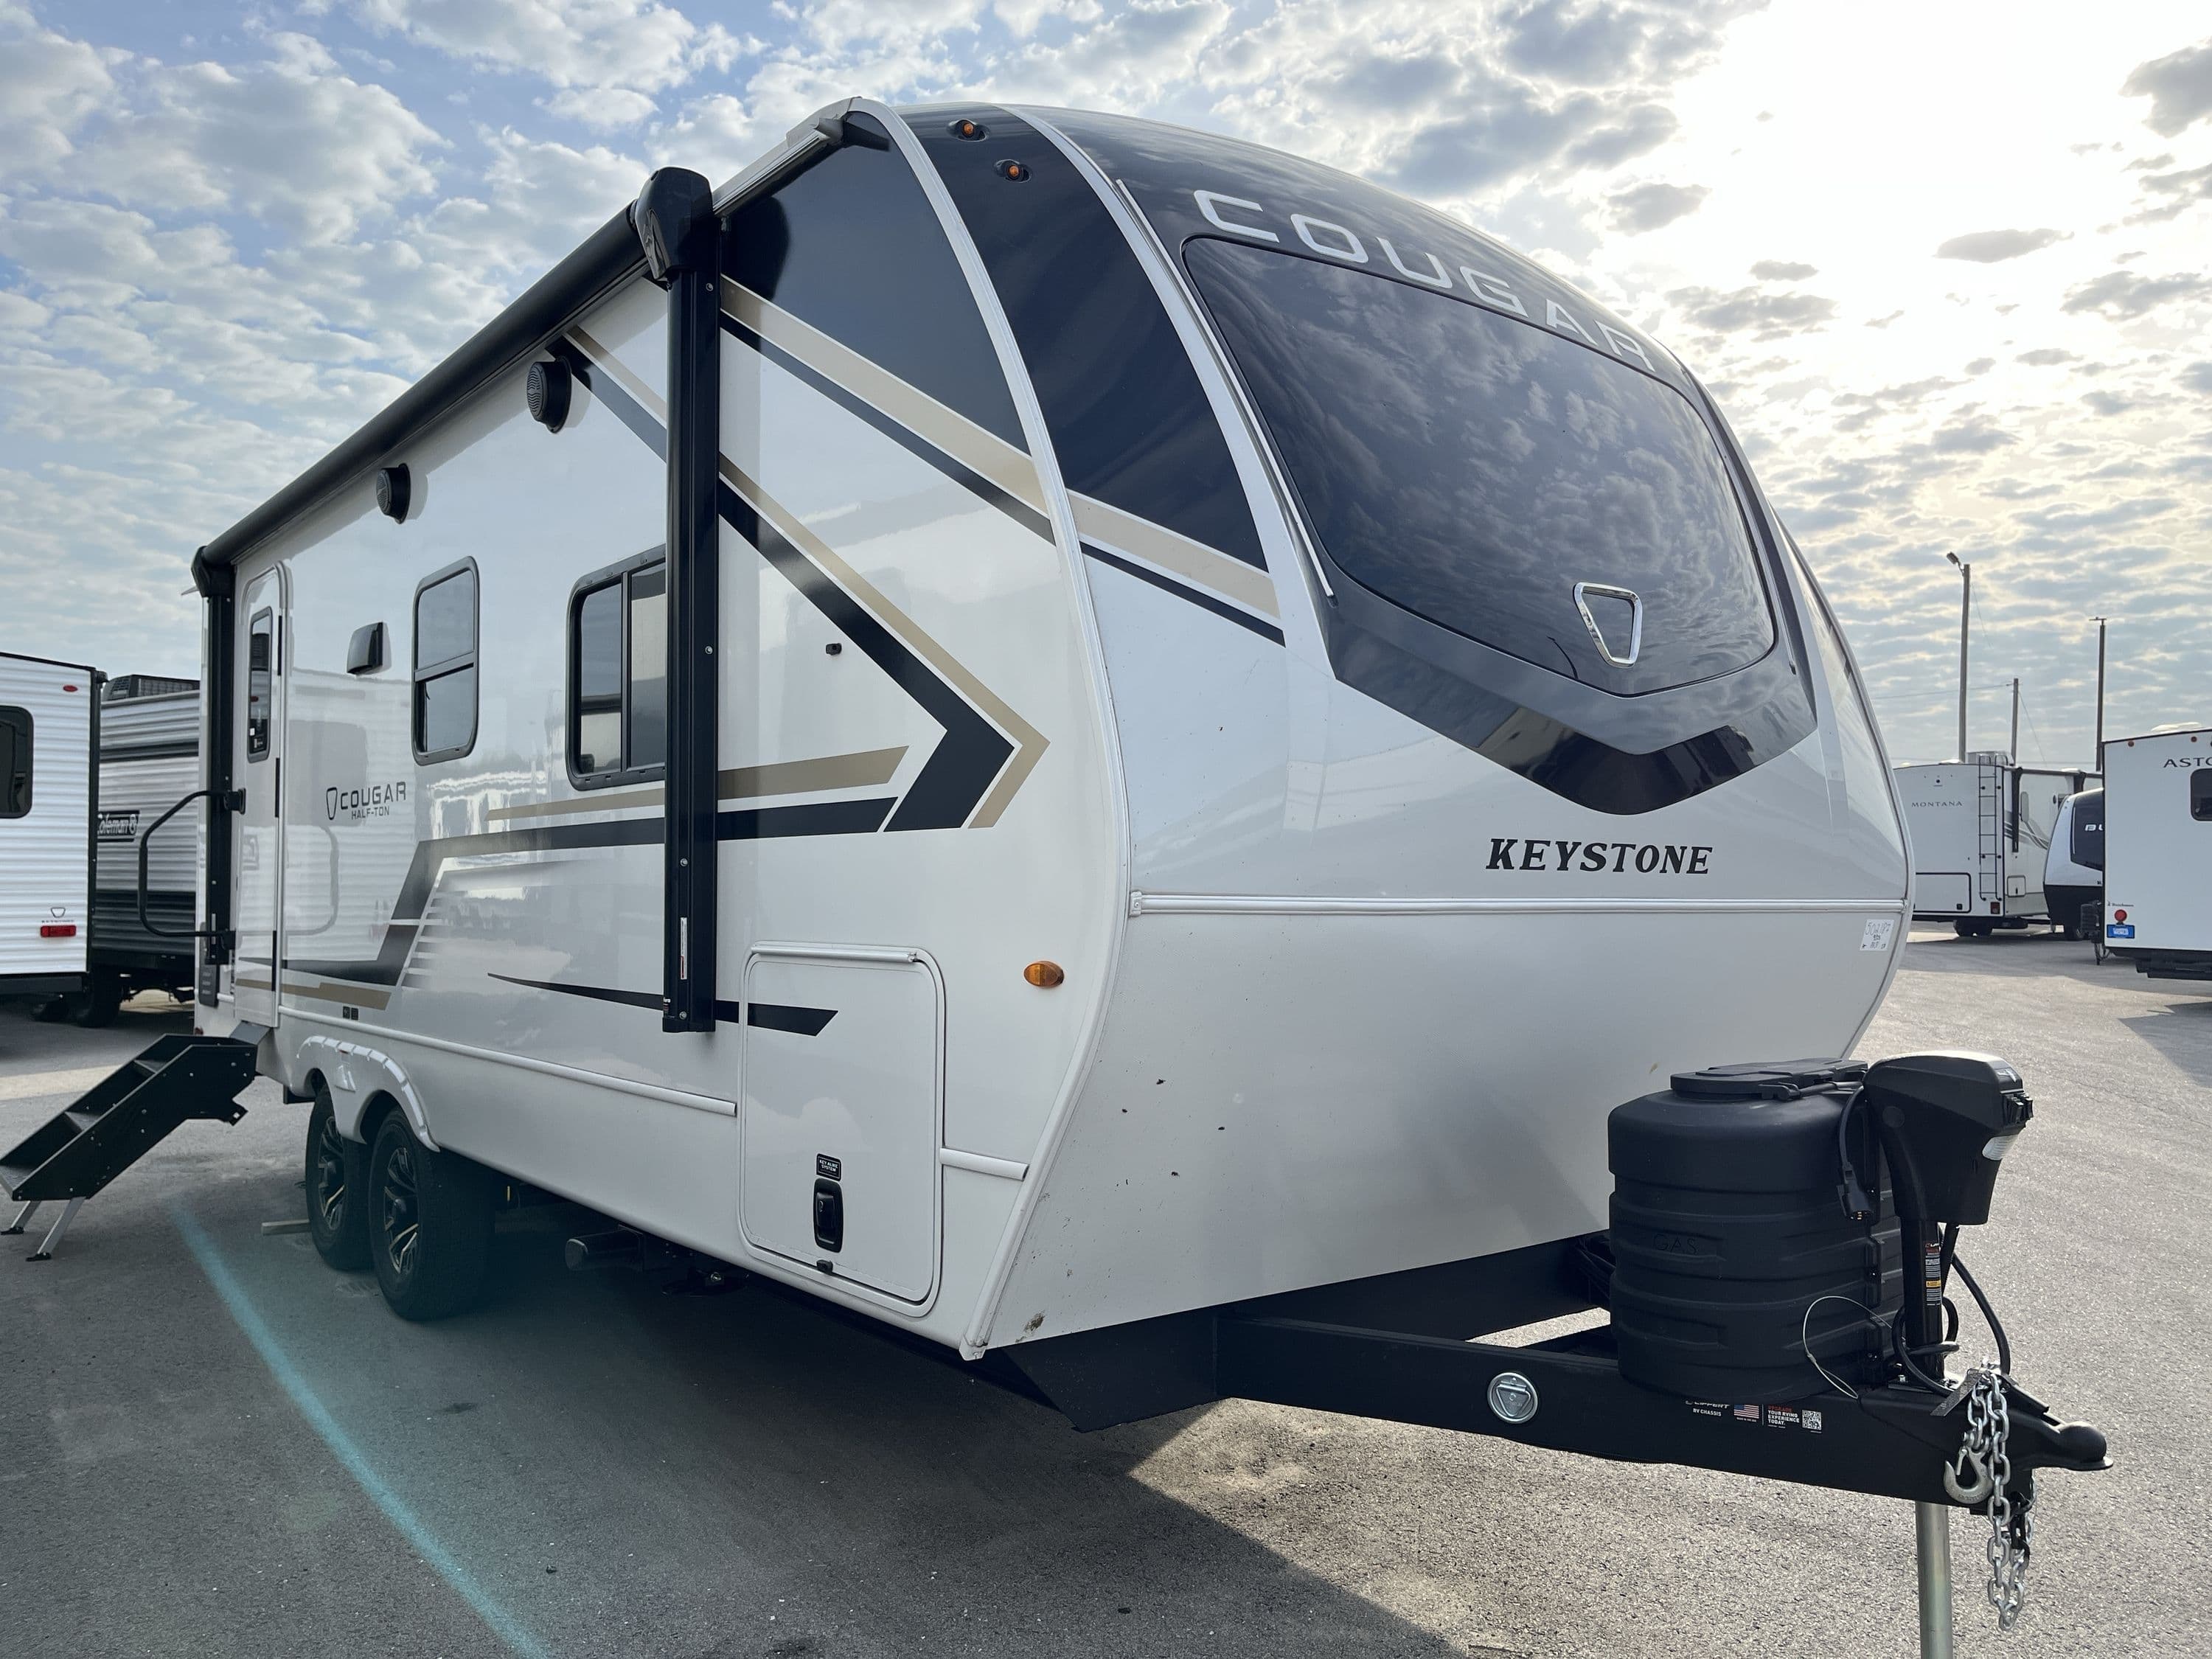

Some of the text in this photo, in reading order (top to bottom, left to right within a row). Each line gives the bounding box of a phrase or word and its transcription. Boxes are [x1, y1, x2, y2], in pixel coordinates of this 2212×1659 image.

[1193, 189, 1656, 372] COUGAR
[340, 782, 406, 810] COUGAR
[351, 806, 390, 820] HALF-TON
[1485, 838, 1714, 874] KEYSTONE
[1767, 1414, 1800, 1423] EXPERIENCE
